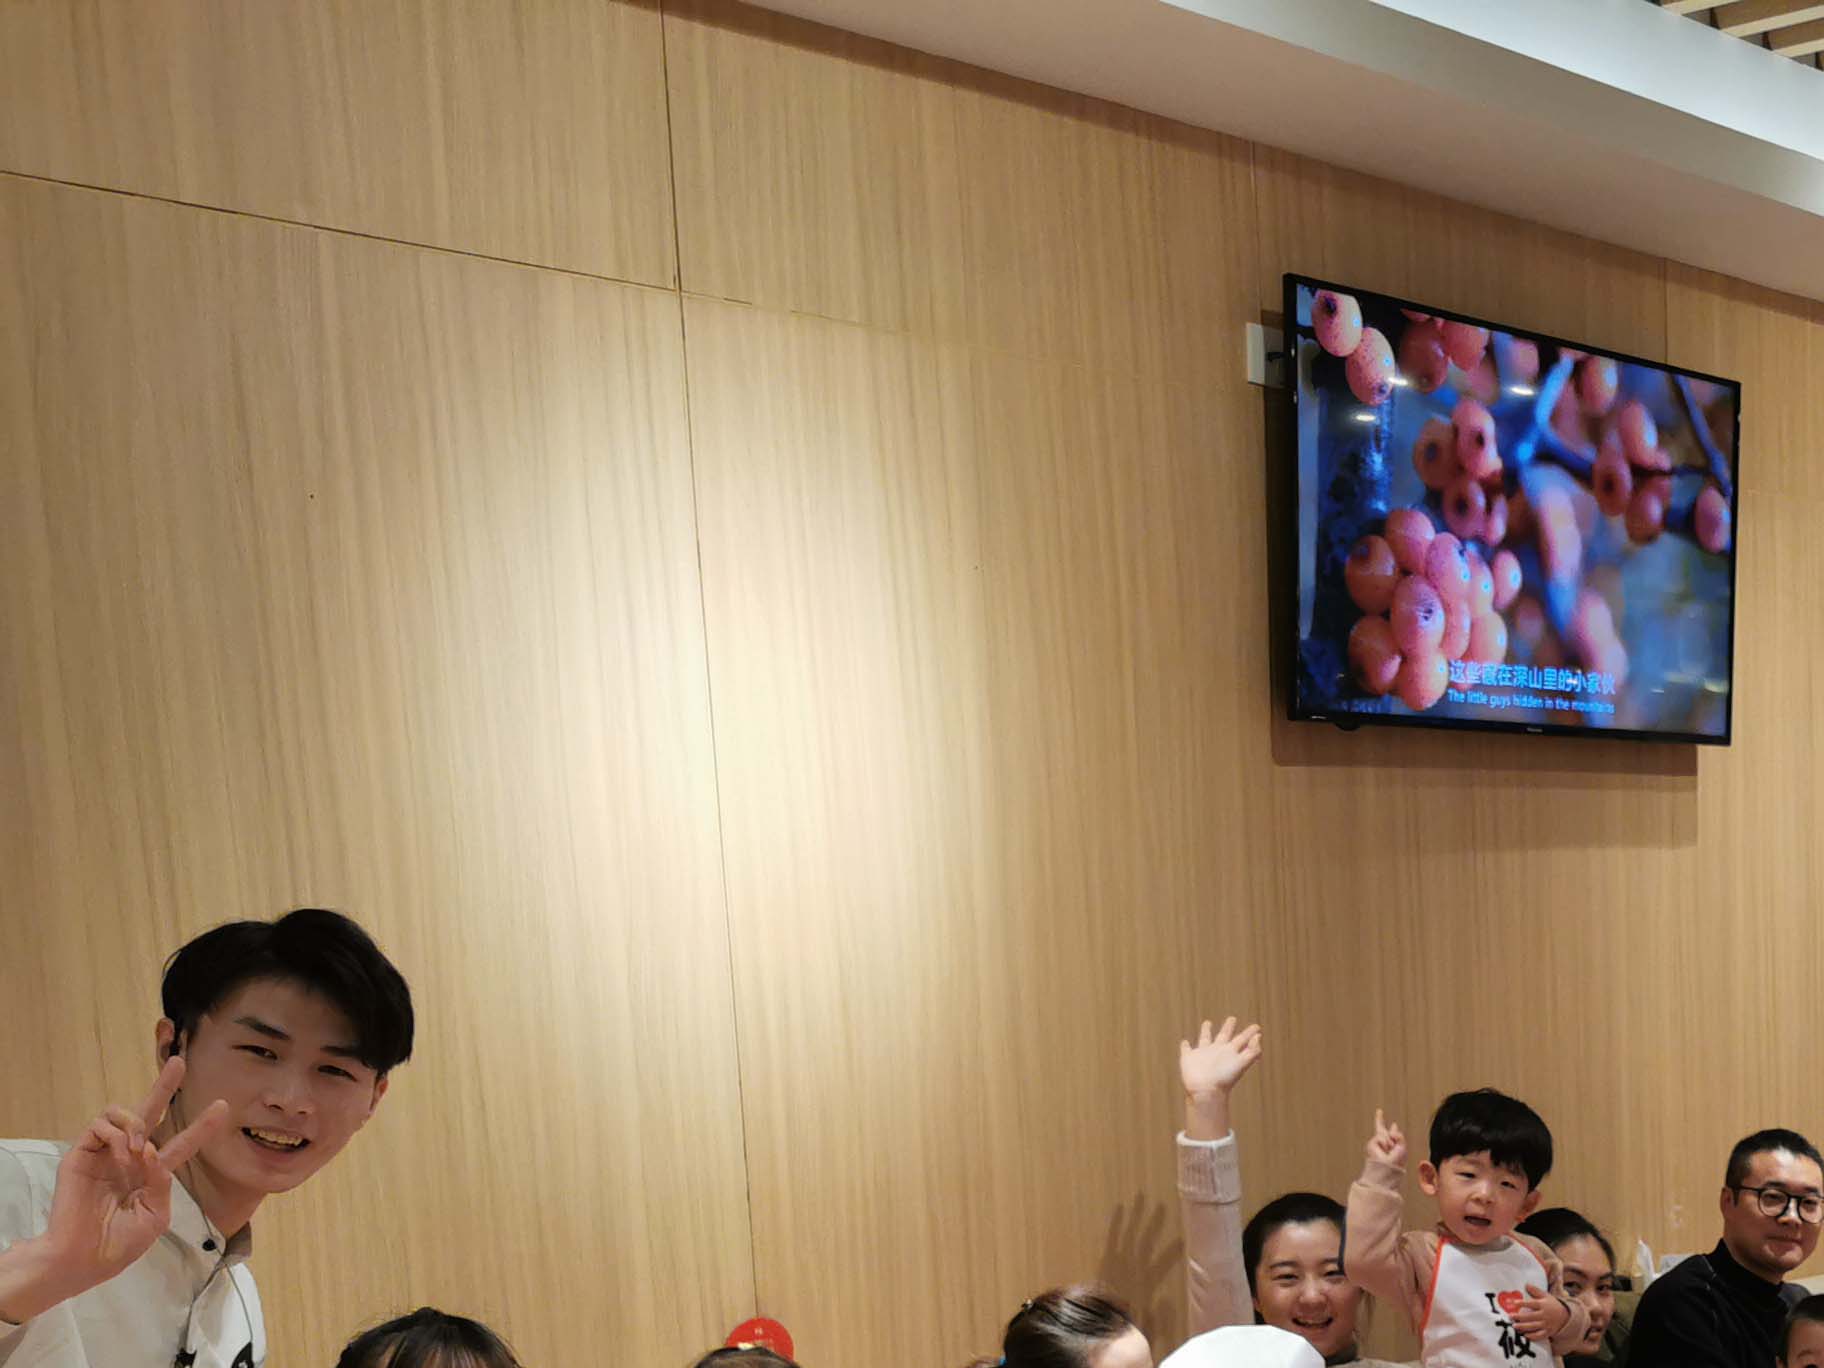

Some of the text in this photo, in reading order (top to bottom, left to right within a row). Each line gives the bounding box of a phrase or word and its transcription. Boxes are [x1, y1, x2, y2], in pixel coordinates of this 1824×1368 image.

[1449, 659, 1617, 695] 这些藏在深山里的小家伙
[1448, 688, 1465, 703] The
[1467, 690, 1489, 704] little
[1490, 695, 1511, 709] guys
[1485, 1292, 1501, 1314] I
